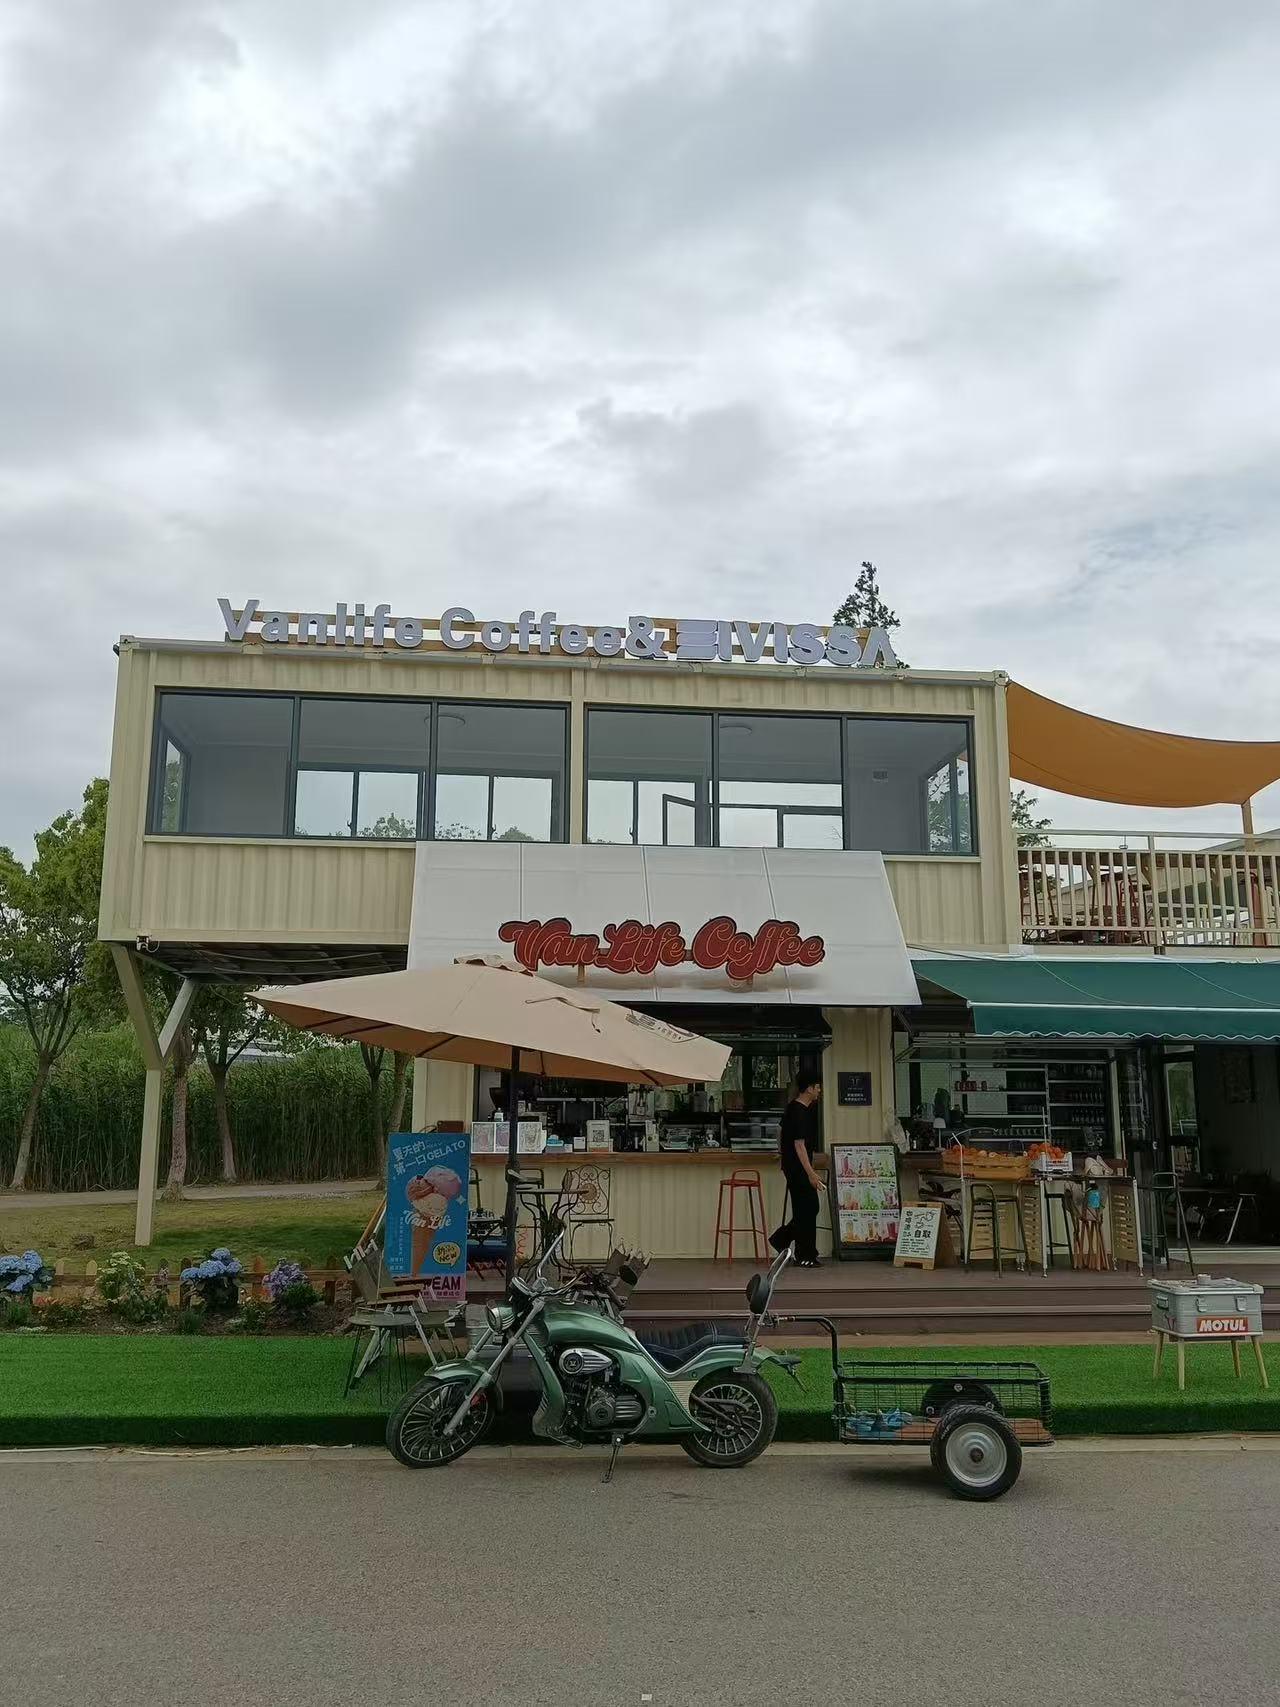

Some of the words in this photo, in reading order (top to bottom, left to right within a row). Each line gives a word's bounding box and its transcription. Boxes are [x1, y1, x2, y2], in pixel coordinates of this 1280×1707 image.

[216, 598, 424, 648] Vanlife
[692, 915, 826, 980] Coffee
[426, 1139, 466, 1161] GELATO
[1199, 1319, 1246, 1332] MOTUL
